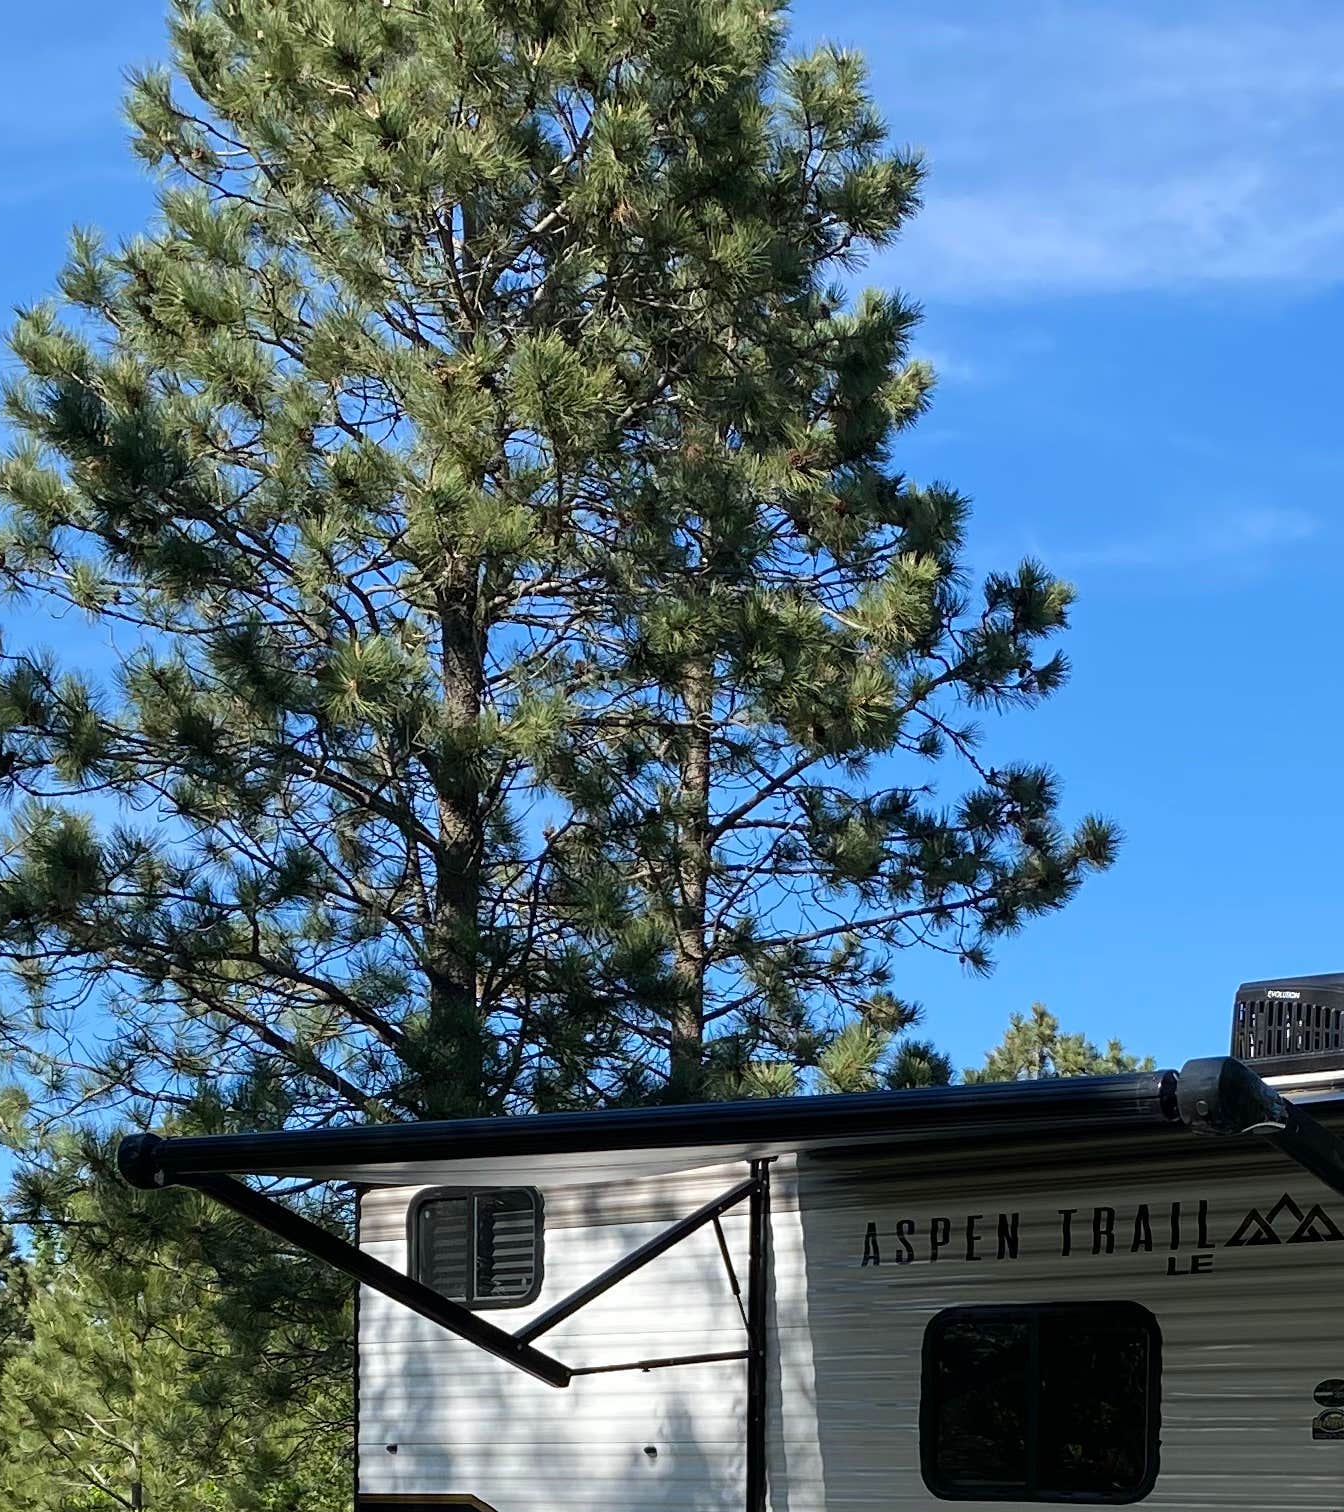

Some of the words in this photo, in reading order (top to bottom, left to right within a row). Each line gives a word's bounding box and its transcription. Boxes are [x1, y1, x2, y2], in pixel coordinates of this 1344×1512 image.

[860, 1212, 1020, 1267] ASPEN
[1057, 1199, 1216, 1257] TRAIL
[1166, 1254, 1214, 1276] LE
